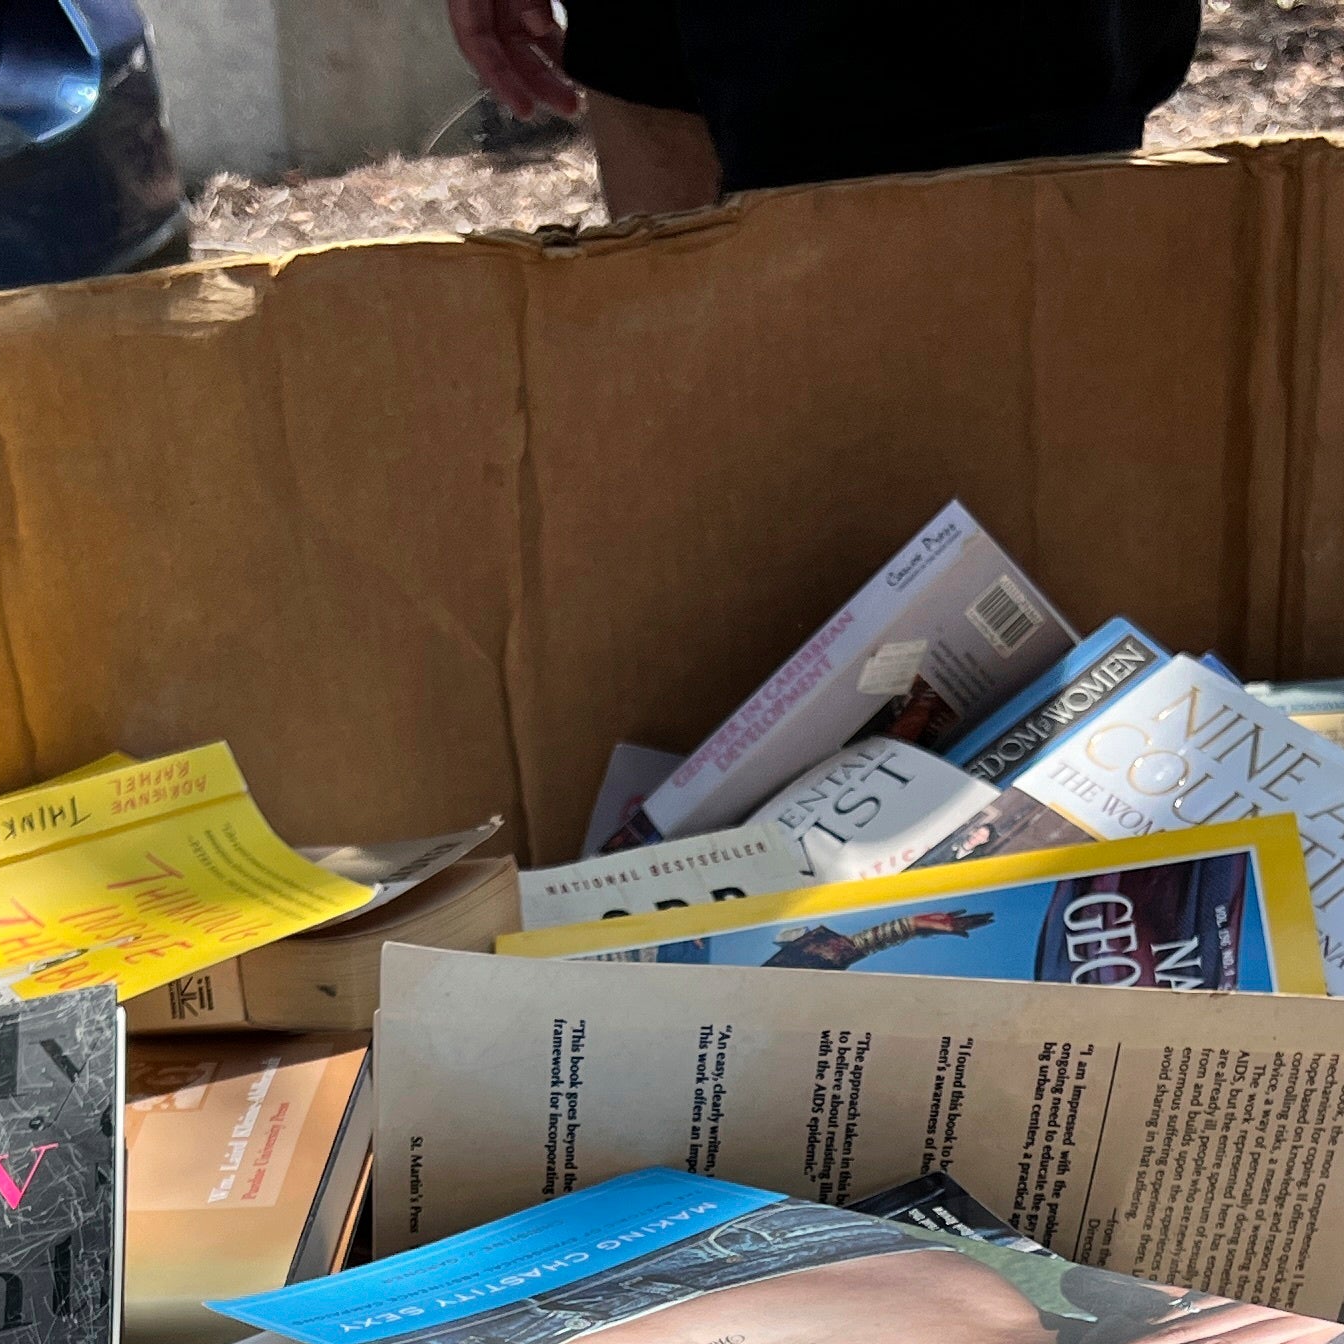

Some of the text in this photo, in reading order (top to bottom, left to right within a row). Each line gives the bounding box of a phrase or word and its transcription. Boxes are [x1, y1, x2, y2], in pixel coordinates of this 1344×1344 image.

[1040, 639, 1147, 728] WOMEN
[1150, 683, 1324, 804] NINE
[105, 758, 193, 798] RAPHEL
[1043, 759, 1107, 803] THE
[1064, 891, 1142, 987] GEO
[1148, 937, 1205, 992] NA
[816, 1029, 834, 1058] with
[1037, 1041, 1057, 1061] big
[567, 1055, 584, 1089] book
[709, 1051, 728, 1082] easy,
[813, 1060, 830, 1081] the
[1032, 1064, 1052, 1101] urban
[1047, 1042, 1074, 1095] ongoing
[1073, 1061, 1088, 1080] am
[539, 1018, 568, 1195] framework for incorporating
[562, 1091, 579, 1121] goes
[705, 1082, 728, 1124] clearly
[809, 1083, 828, 1114] AIDS
[1046, 1096, 1064, 1127] need
[1057, 1084, 1085, 1146] impressed
[251, 1123, 283, 1165] University
[267, 1101, 290, 1122] Press
[410, 1135, 423, 1151] St.
[559, 1123, 579, 1168] beyond
[1020, 1103, 1044, 1150] centers,
[1043, 1129, 1058, 1143] to
[702, 1125, 723, 1172] written,
[1033, 1144, 1055, 1191] educate
[1055, 1149, 1072, 1176] with
[562, 1171, 576, 1193] the
[1009, 1162, 1035, 1210] practical
[1050, 1179, 1066, 1199] the
[407, 1205, 421, 1235] Press
[1029, 1193, 1046, 1212] the
[335, 1199, 724, 1333] MAKING CHASTITY SEXY
